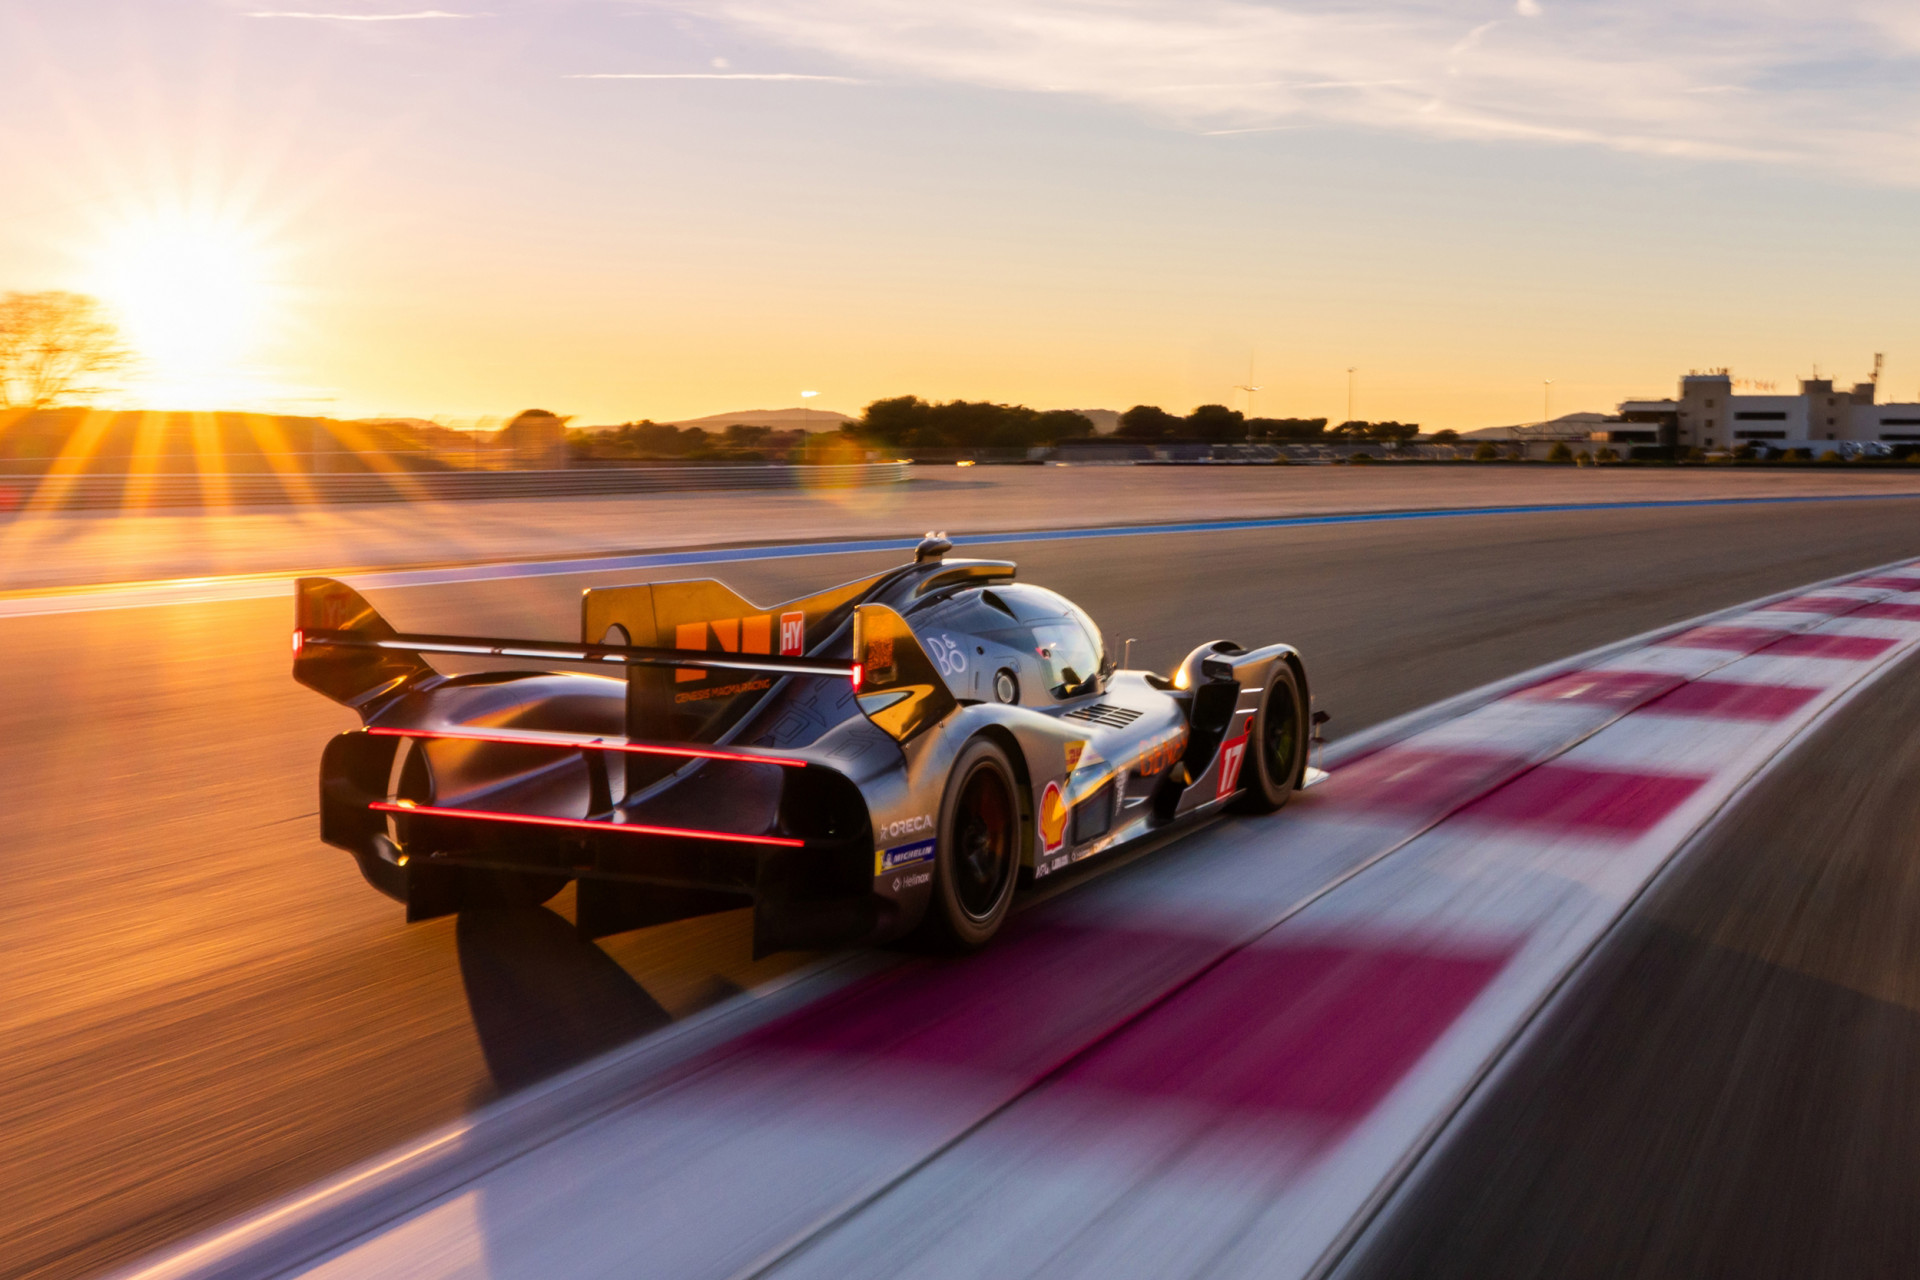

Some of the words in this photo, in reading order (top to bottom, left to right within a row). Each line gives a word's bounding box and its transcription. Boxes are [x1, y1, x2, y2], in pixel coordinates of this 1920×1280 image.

[782, 620, 802, 651] HY
[1220, 744, 1245, 793] 17
[889, 815, 932, 837] ORECA
[893, 846, 932, 864] MICHELIN
